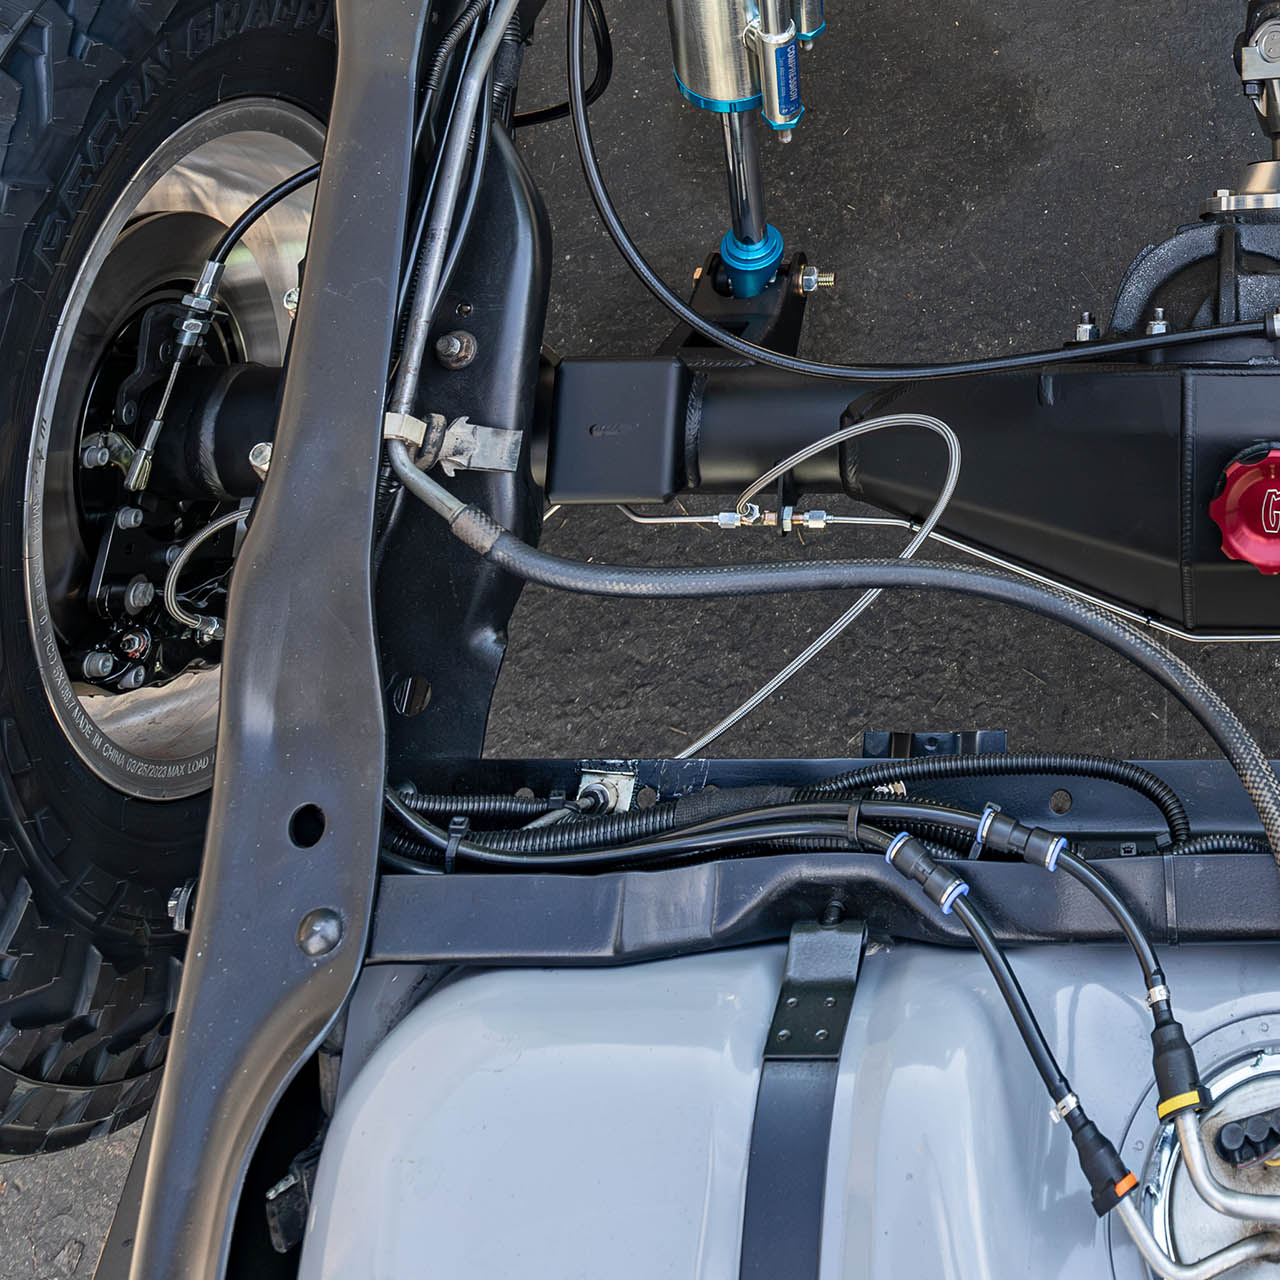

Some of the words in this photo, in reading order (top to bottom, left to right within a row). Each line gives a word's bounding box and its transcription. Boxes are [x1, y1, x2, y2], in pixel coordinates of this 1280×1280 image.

[787, 45, 798, 102] COMPRESSION
[43, 632, 58, 666] PCD
[71, 706, 94, 739] MADE
[91, 733, 103, 751] IN
[102, 743, 126, 769] CHINA
[167, 763, 186, 779] MAX
[187, 756, 209, 774] LOAD
